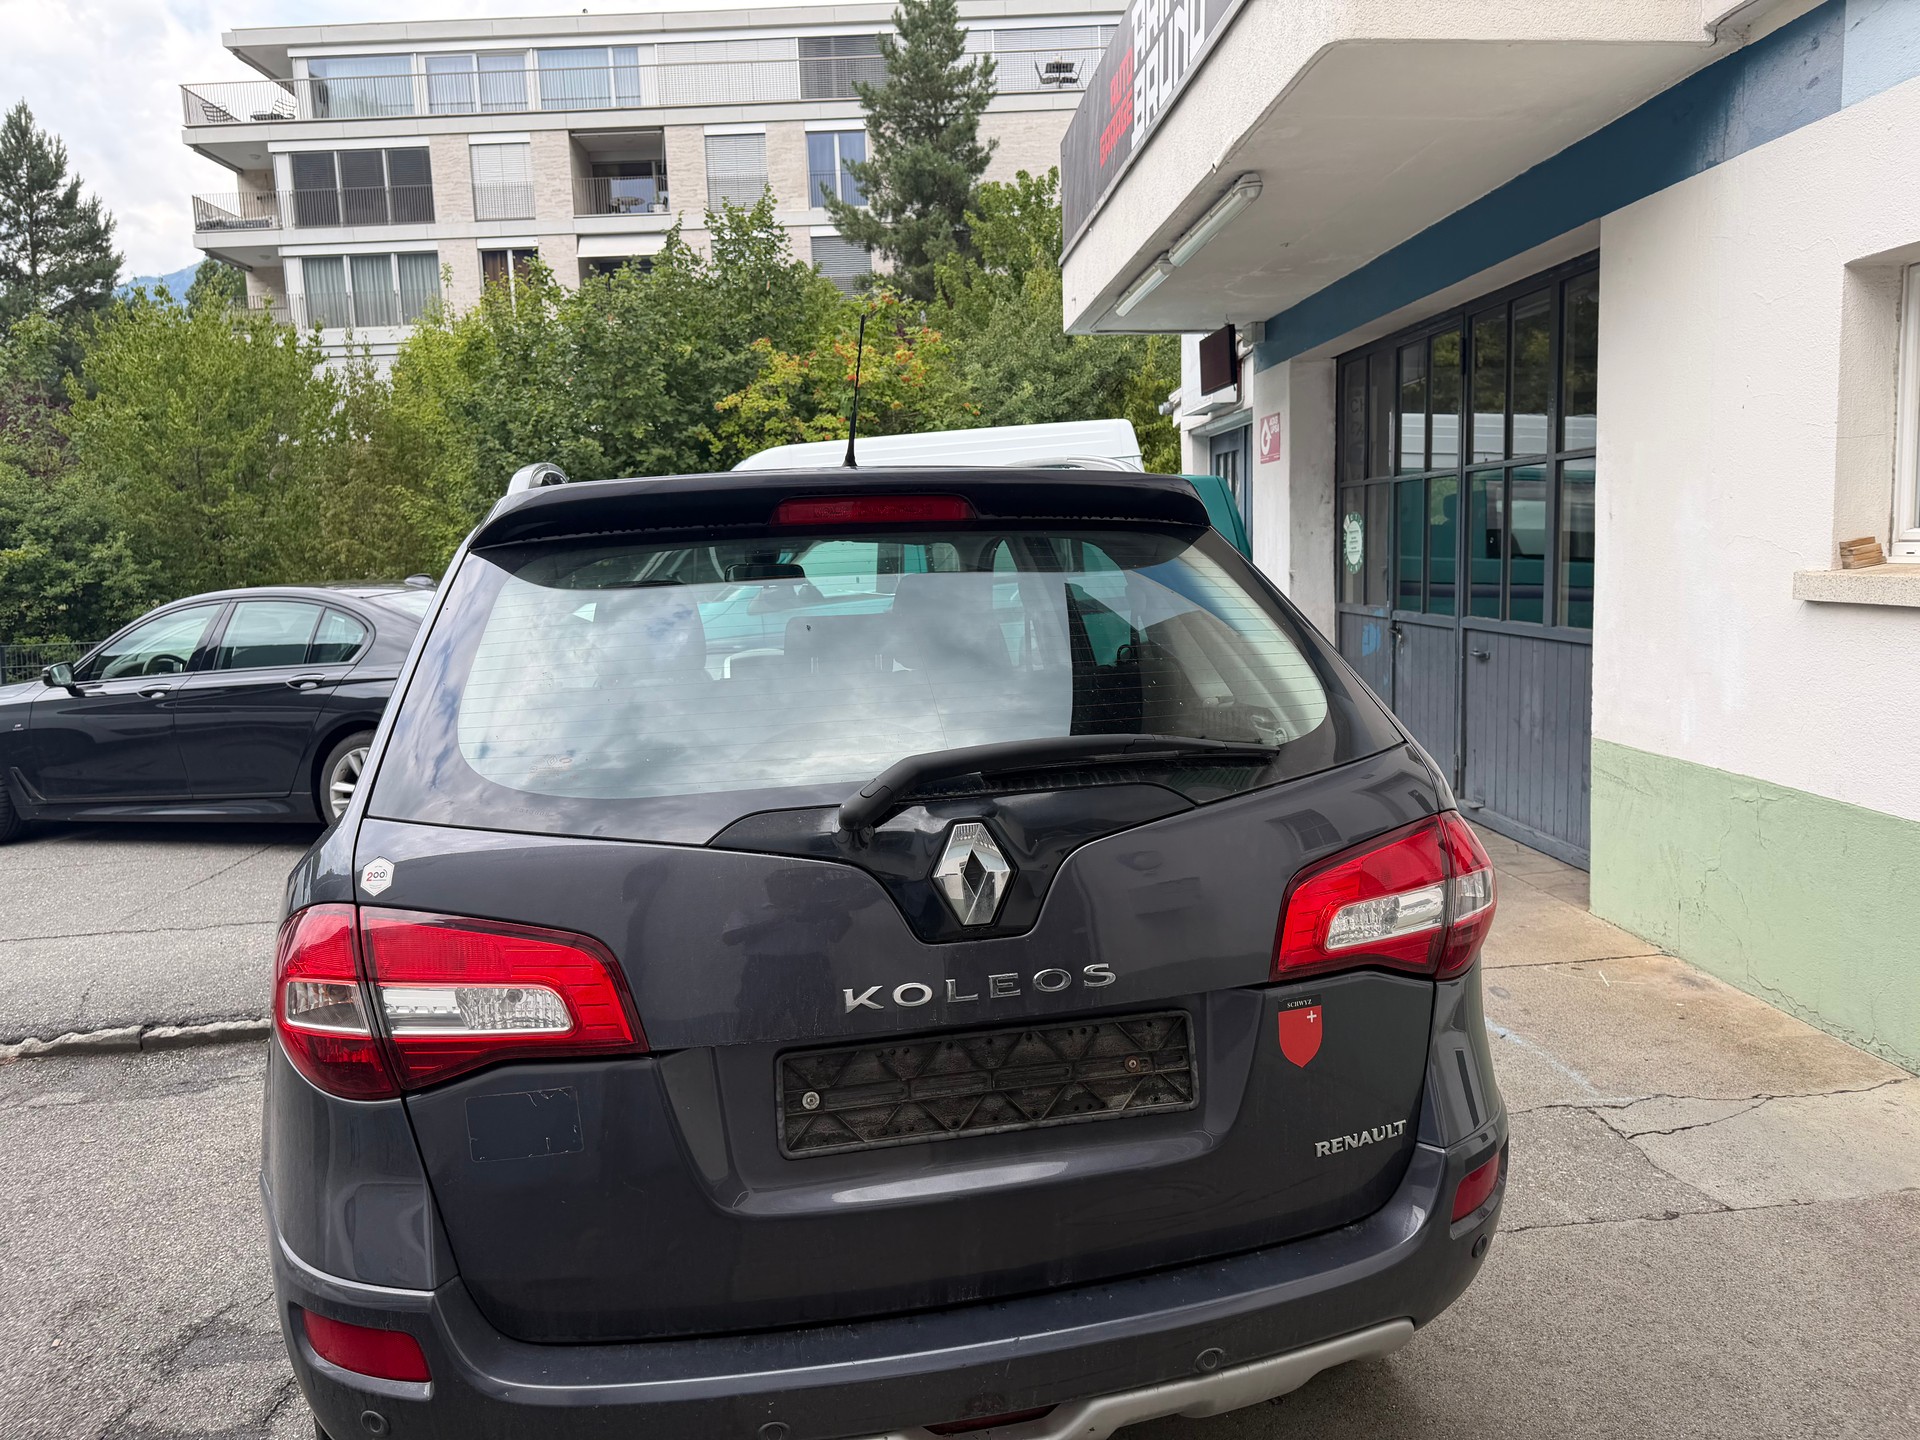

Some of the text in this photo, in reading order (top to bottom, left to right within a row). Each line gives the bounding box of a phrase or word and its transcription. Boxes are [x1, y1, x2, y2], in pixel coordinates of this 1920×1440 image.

[1110, 46, 1133, 114] AUTO
[1099, 86, 1133, 169] GARAGE
[843, 963, 1117, 1014] KOLEOS
[1287, 998, 1313, 1009] SCHWYZ
[1315, 1119, 1407, 1158] RENAULT
